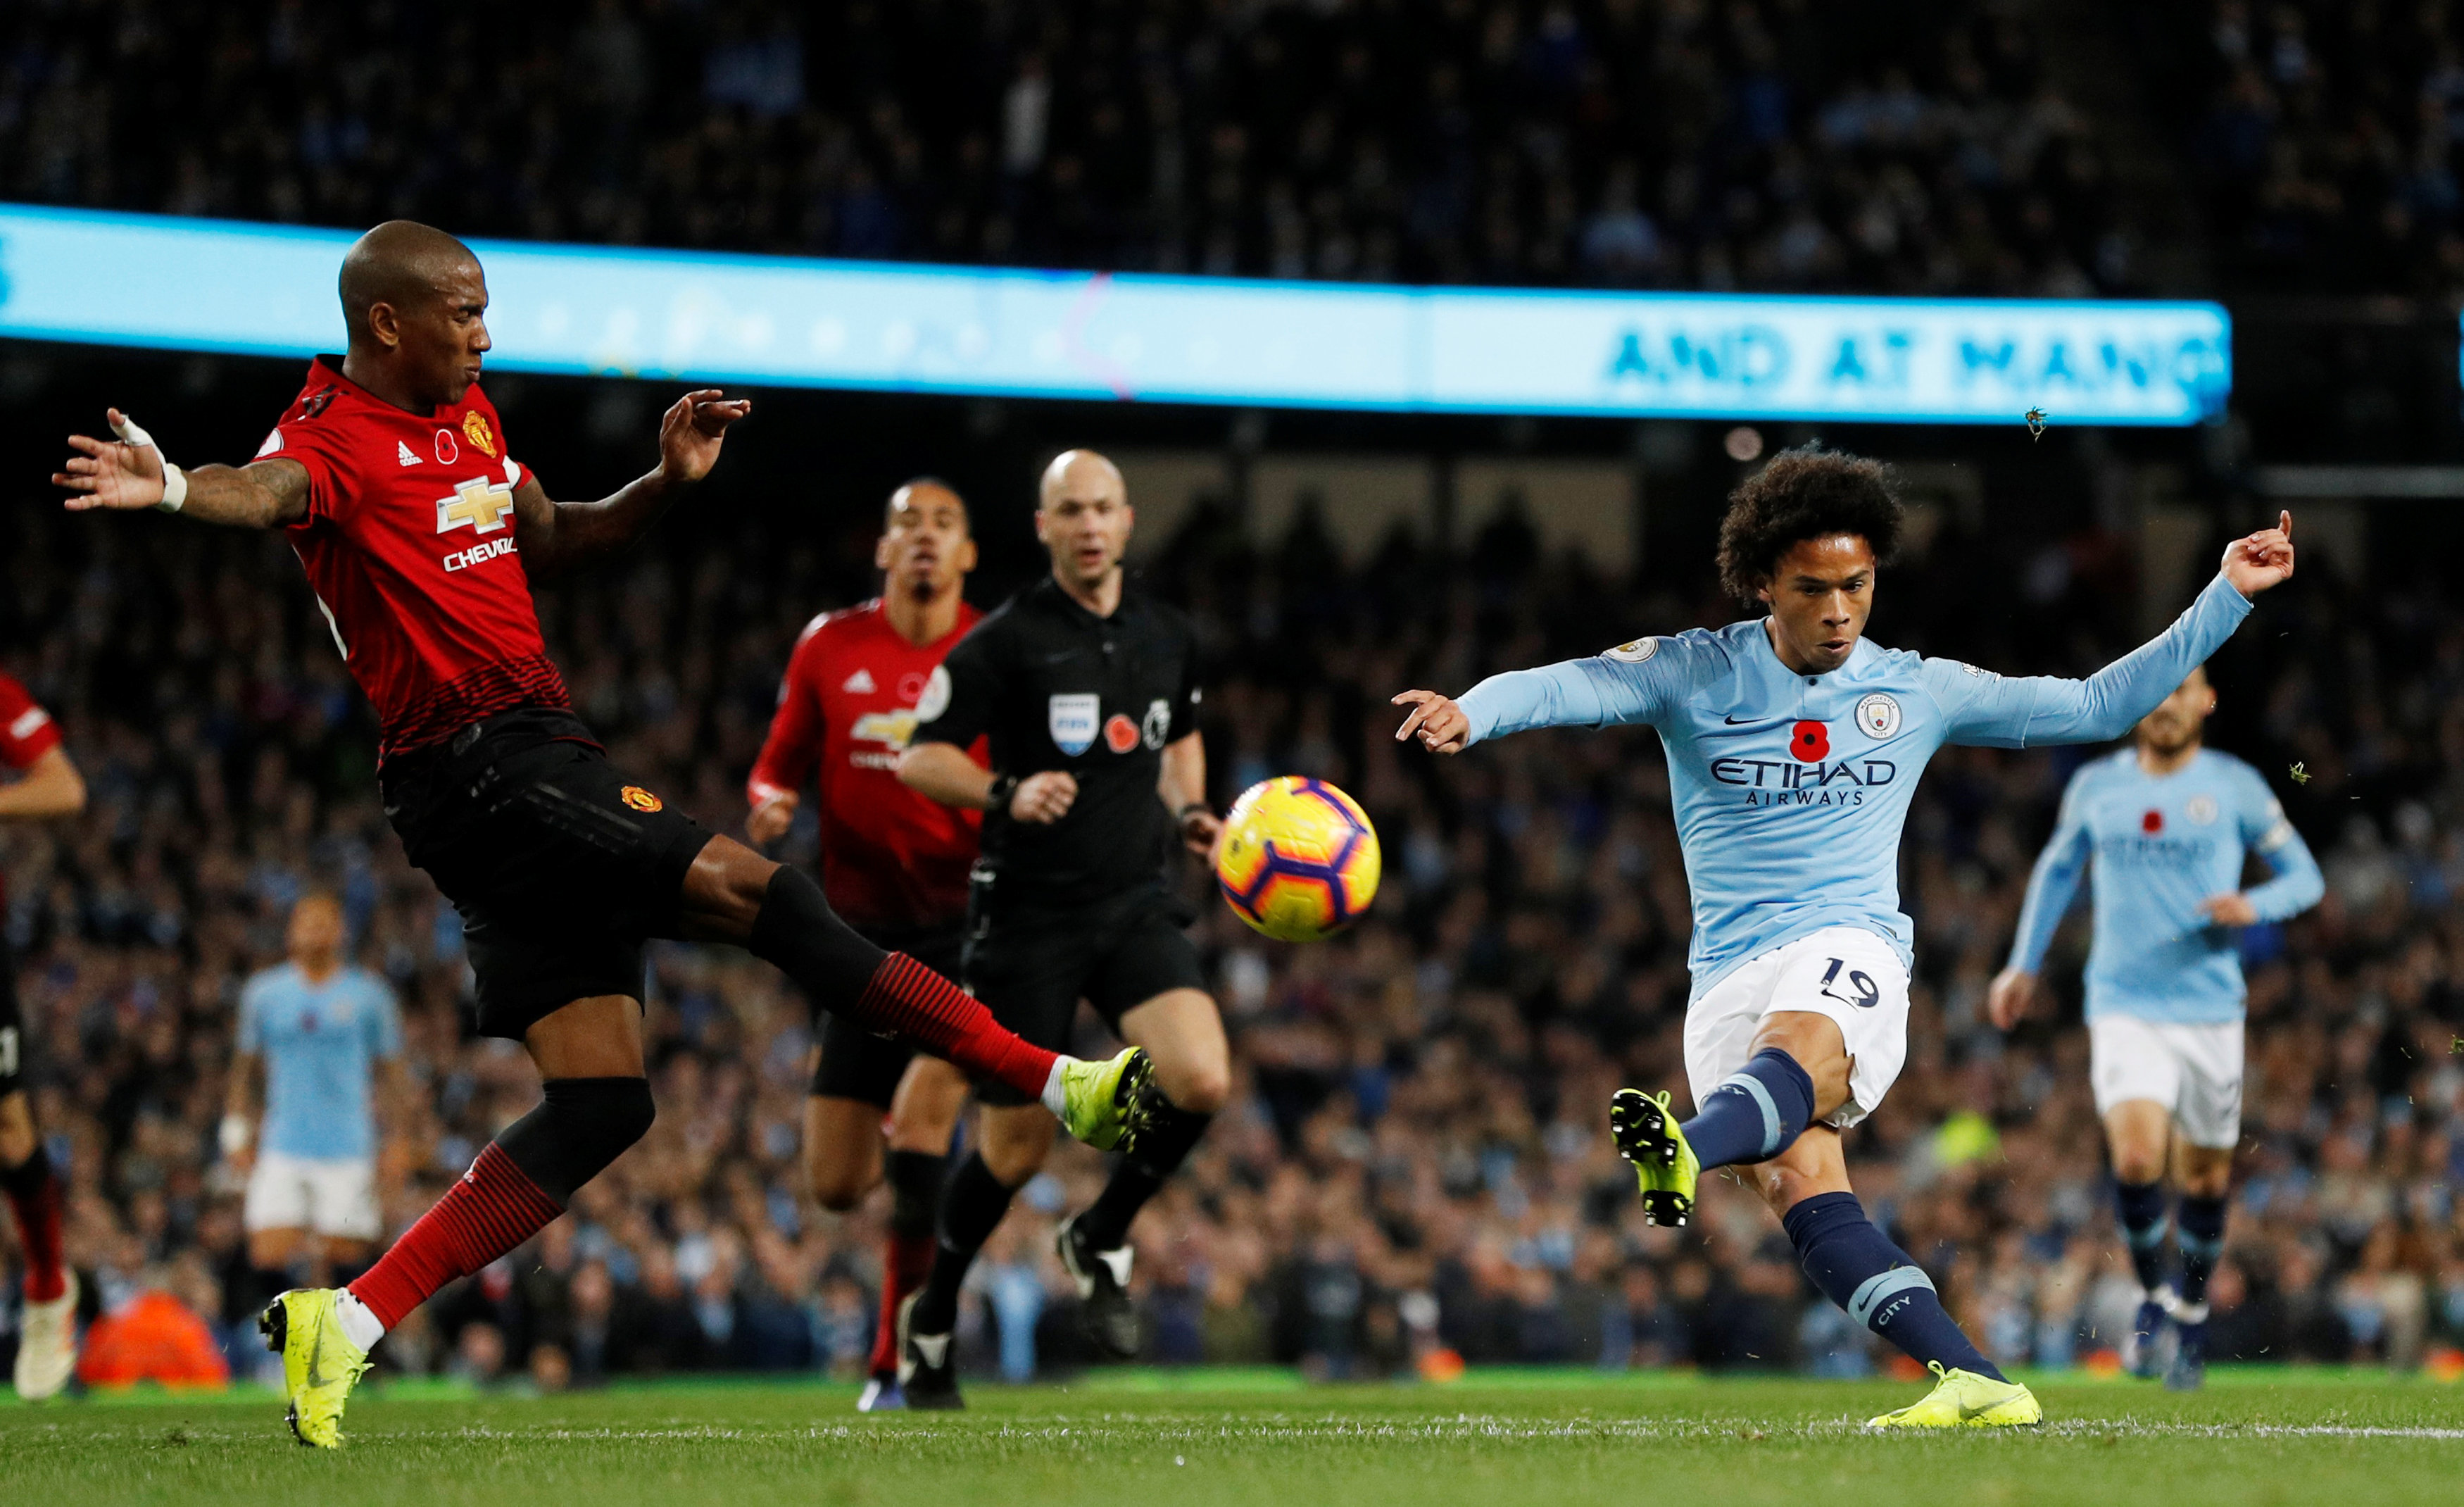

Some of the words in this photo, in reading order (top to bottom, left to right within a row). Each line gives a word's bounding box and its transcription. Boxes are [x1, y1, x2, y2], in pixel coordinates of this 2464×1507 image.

[1609, 327, 1792, 388] AND
[1823, 330, 1919, 391] AT
[1860, 696, 1897, 710] MANCHESTER
[1711, 758, 1896, 788] ETIHAD
[1746, 791, 1863, 806] AIRWAYS
[1820, 957, 1879, 1008] 19
[1878, 1296, 1911, 1325] CITY
